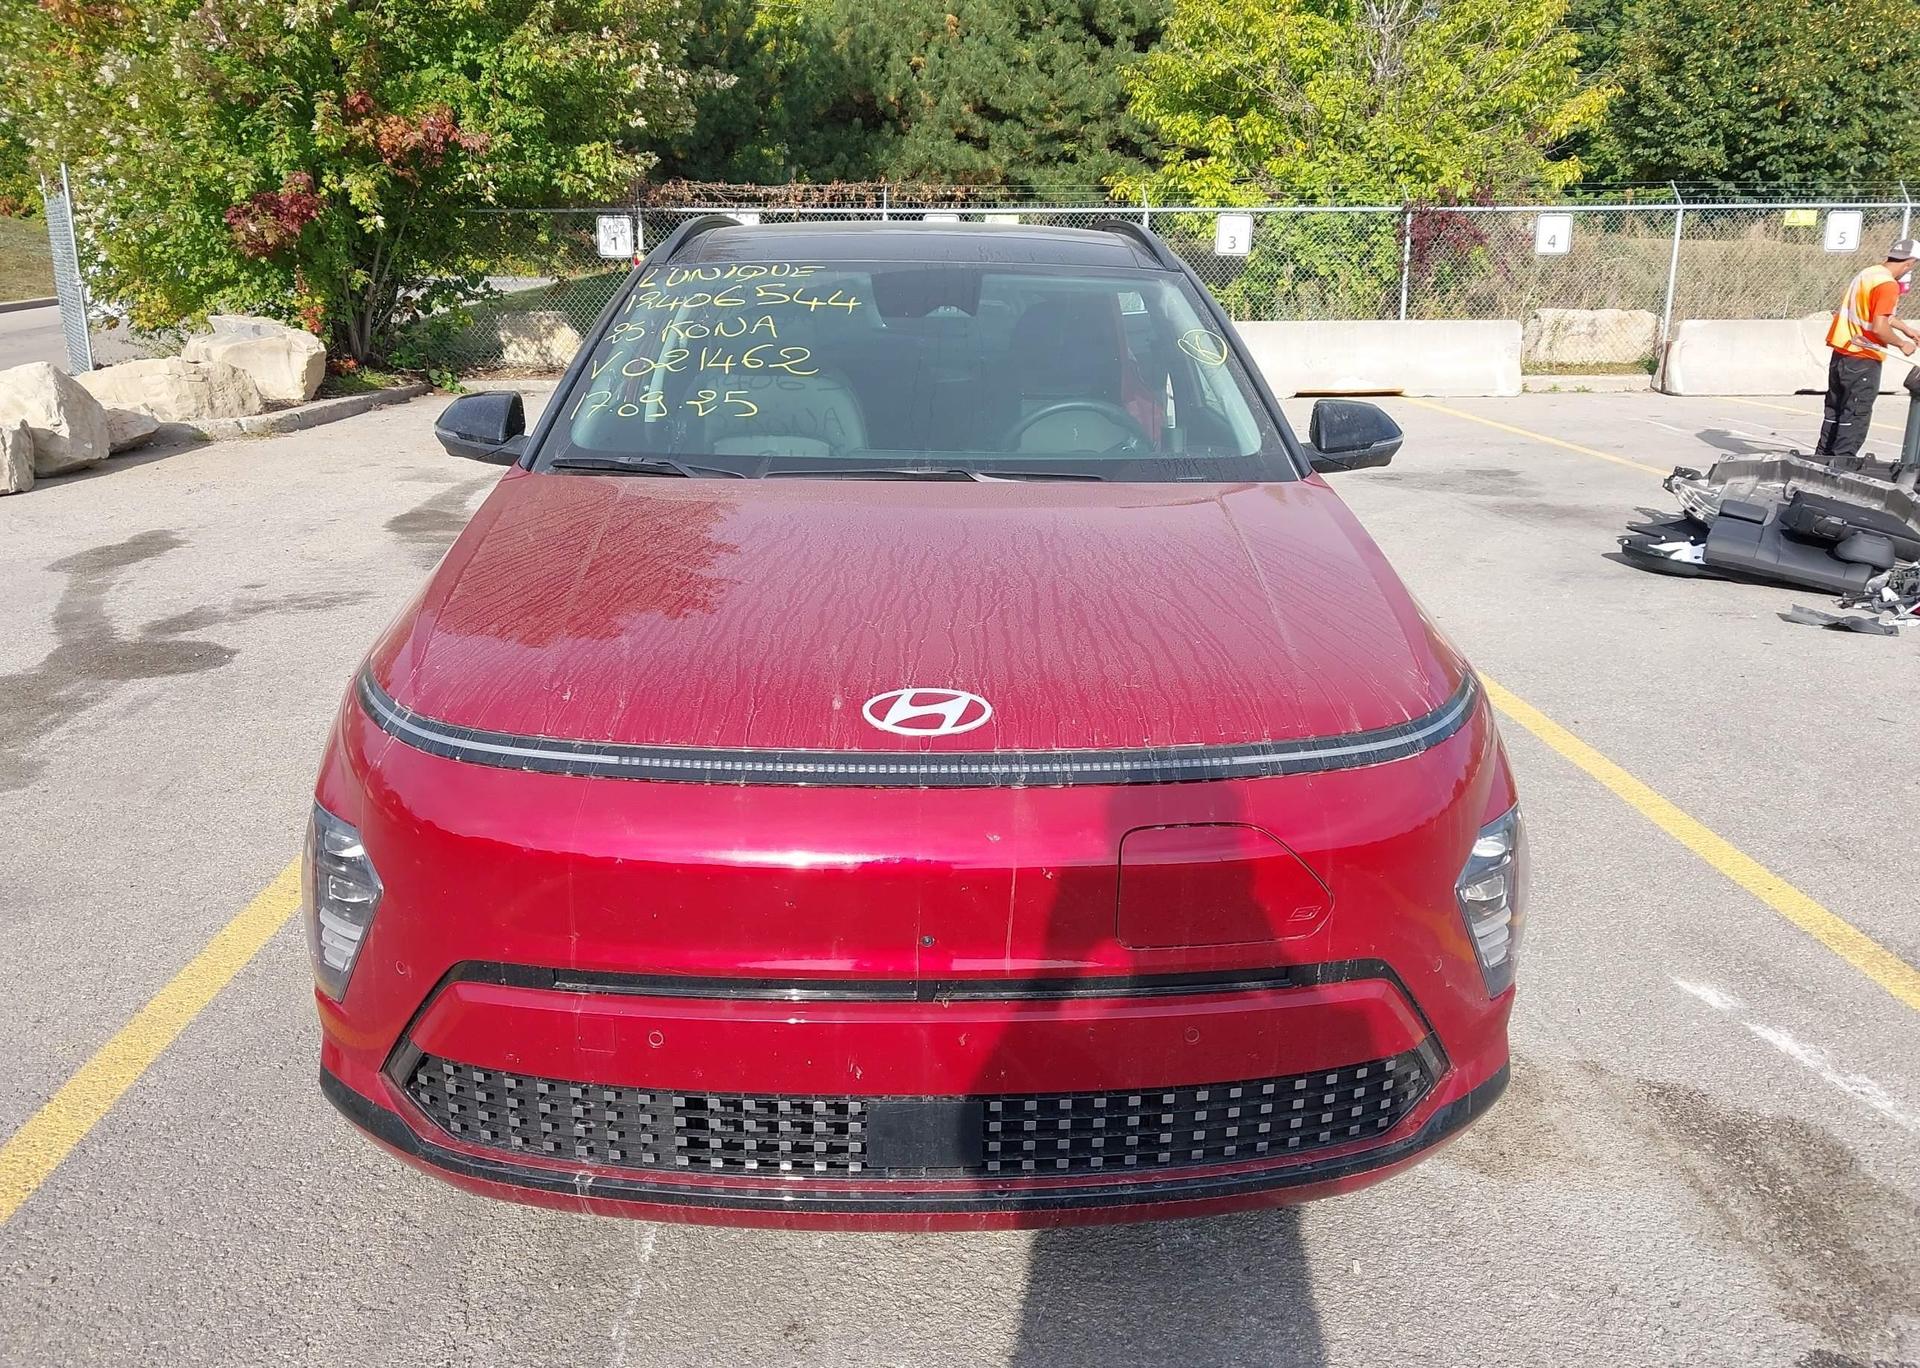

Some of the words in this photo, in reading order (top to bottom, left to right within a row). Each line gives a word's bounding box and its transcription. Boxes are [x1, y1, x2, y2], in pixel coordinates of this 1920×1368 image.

[610, 236, 618, 251] 1
[1227, 235, 1237, 250] 3
[1547, 234, 1556, 249] 4
[1837, 231, 1847, 245] 5
